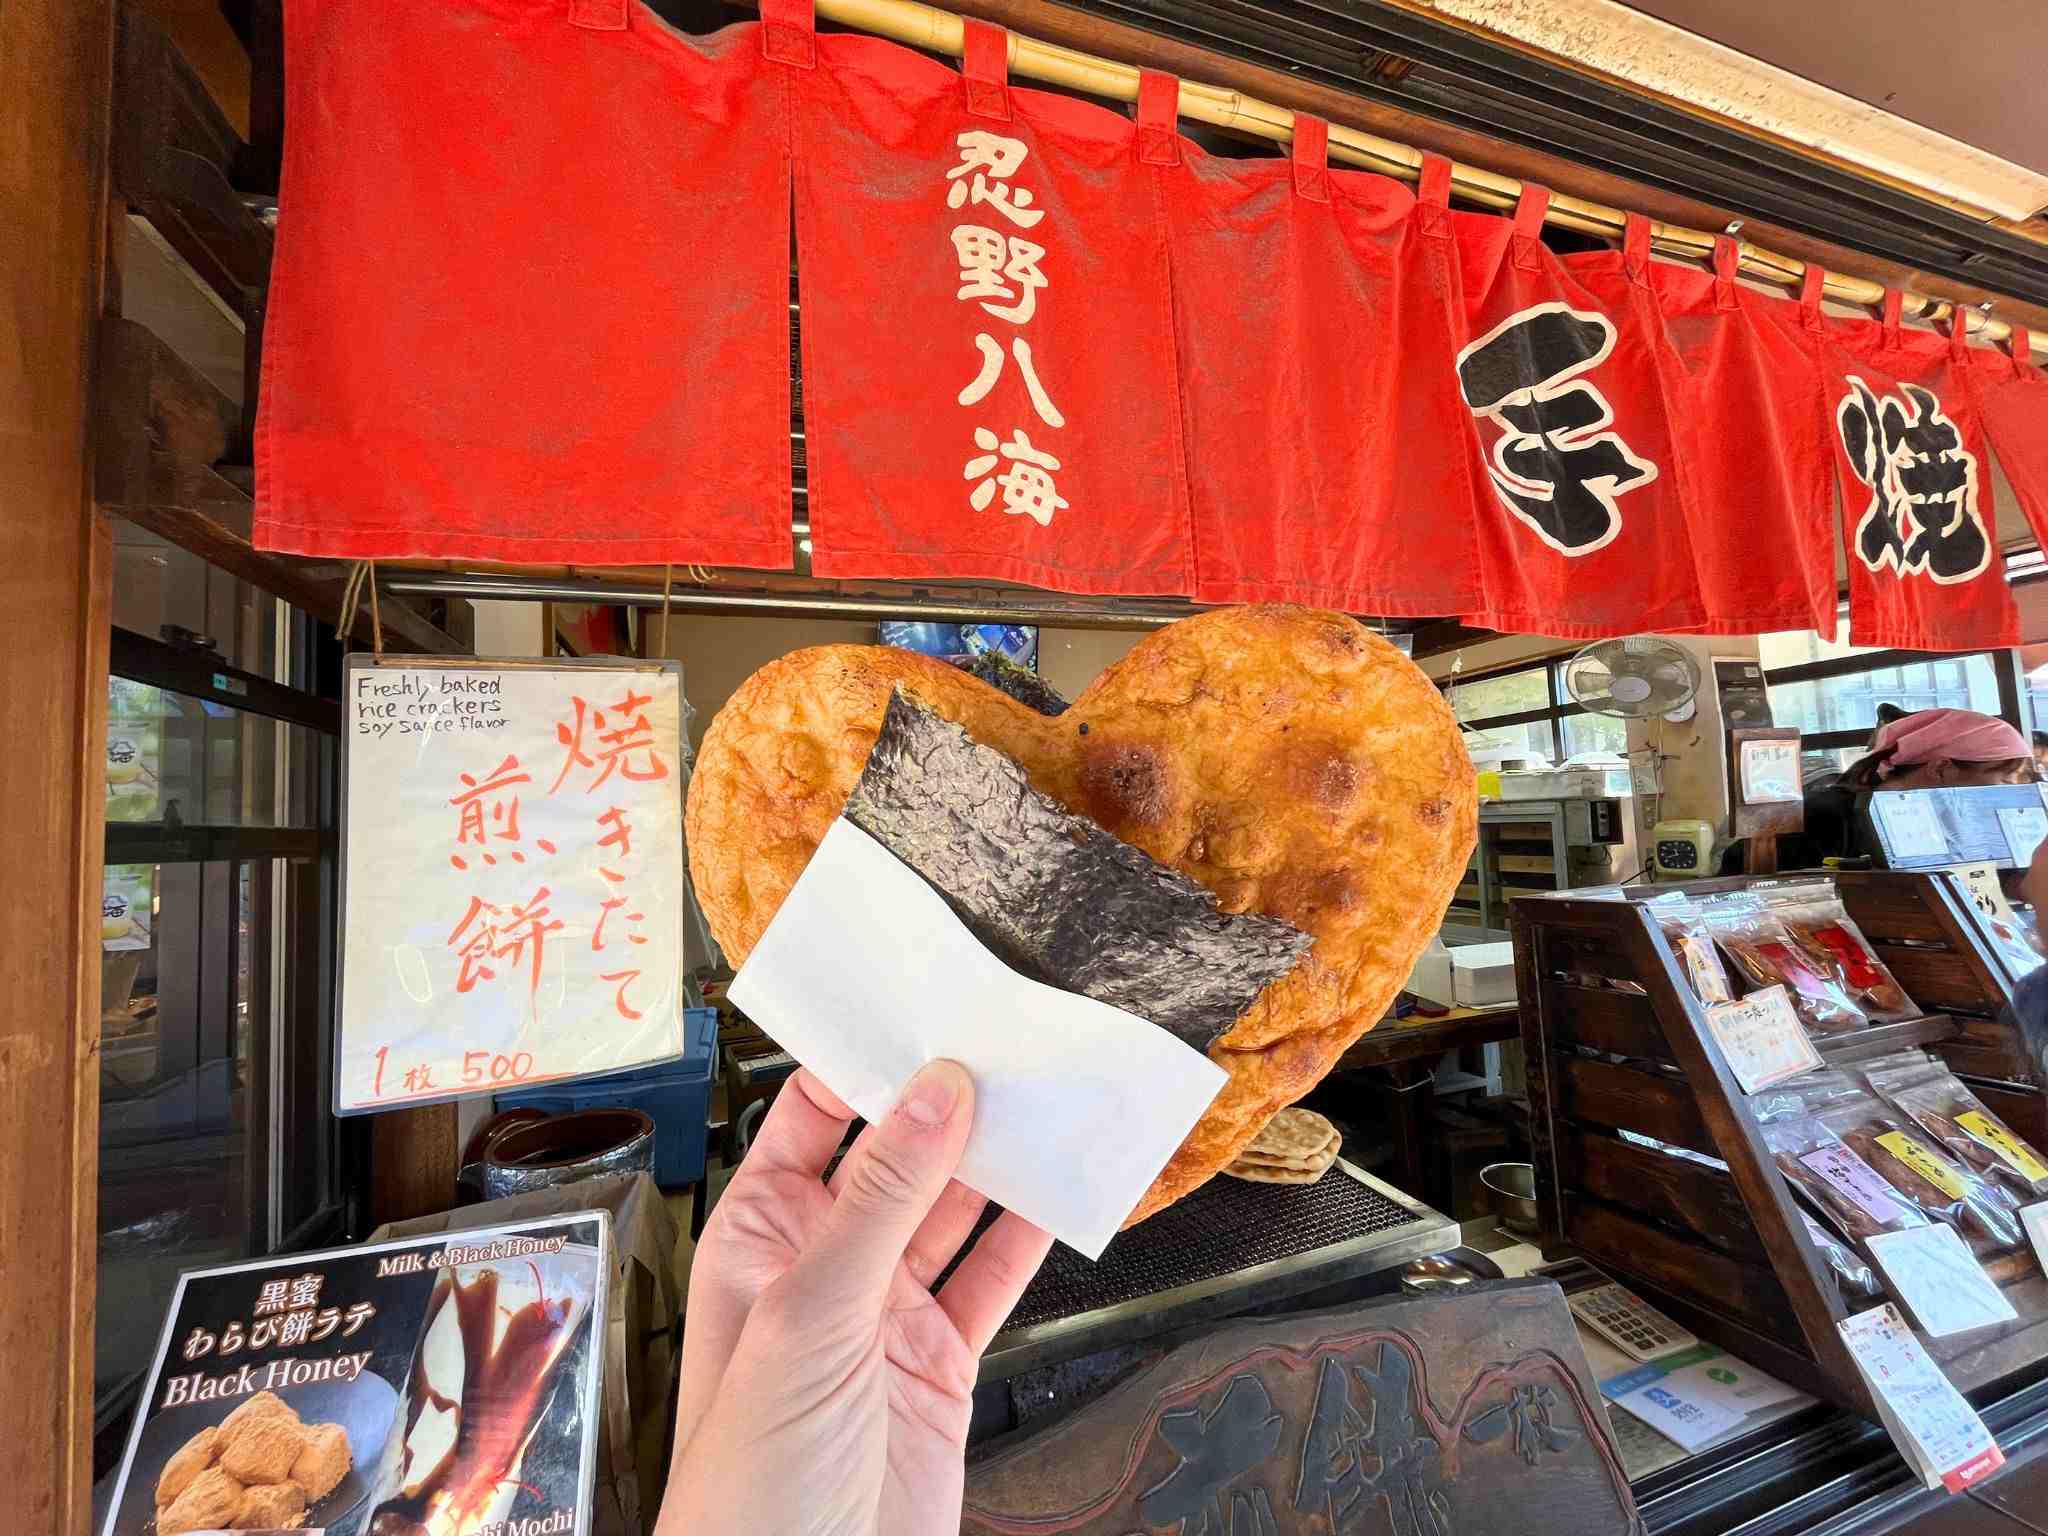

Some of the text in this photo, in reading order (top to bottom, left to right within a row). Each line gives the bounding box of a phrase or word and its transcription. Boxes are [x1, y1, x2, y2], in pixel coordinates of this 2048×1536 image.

[945, 130, 1070, 527] 忍野八海
[358, 675, 502, 702] Freshly baked
[358, 696, 502, 718] rice crackers
[359, 721, 394, 740] soy
[460, 715, 511, 731] flavor
[548, 688, 670, 1020] 焼きたて
[447, 753, 564, 1023] 煎餅
[463, 1051, 534, 1083] 500
[376, 1235, 569, 1278] Milk & Black Honey
[254, 1273, 324, 1315] 黒蜜
[184, 1301, 376, 1360] わらび餅ラテ
[162, 1350, 373, 1408] Black Honey
[507, 1507, 574, 1536] Mochi
